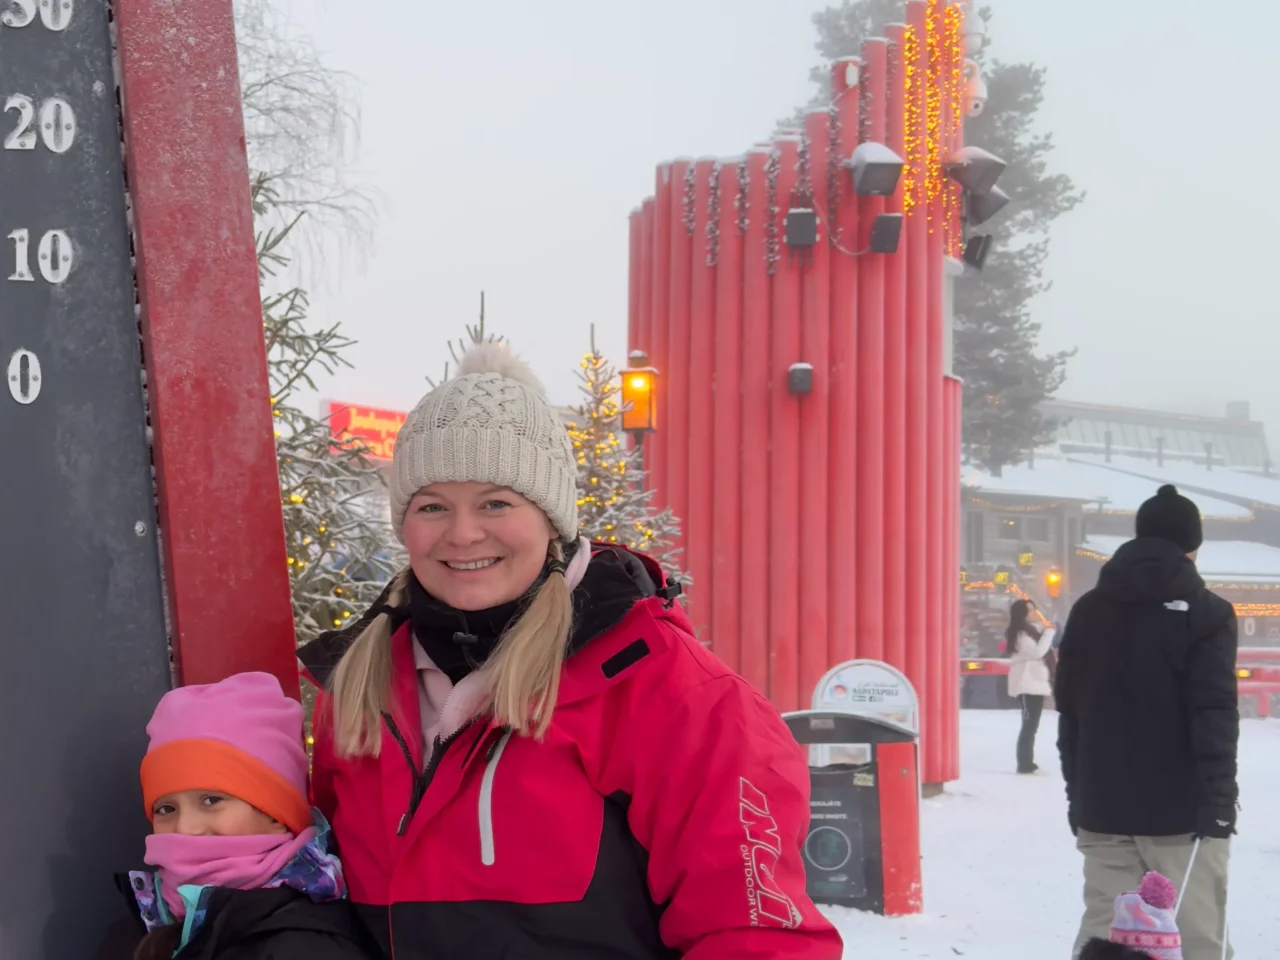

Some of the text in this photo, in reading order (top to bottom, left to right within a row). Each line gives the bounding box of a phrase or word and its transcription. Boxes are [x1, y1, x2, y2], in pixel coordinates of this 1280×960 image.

[3, 94, 76, 153] 20
[6, 227, 73, 284] 10
[7, 349, 42, 404] 0
[739, 775, 794, 929] INUI
[739, 844, 760, 927] OUTDOOR WE
